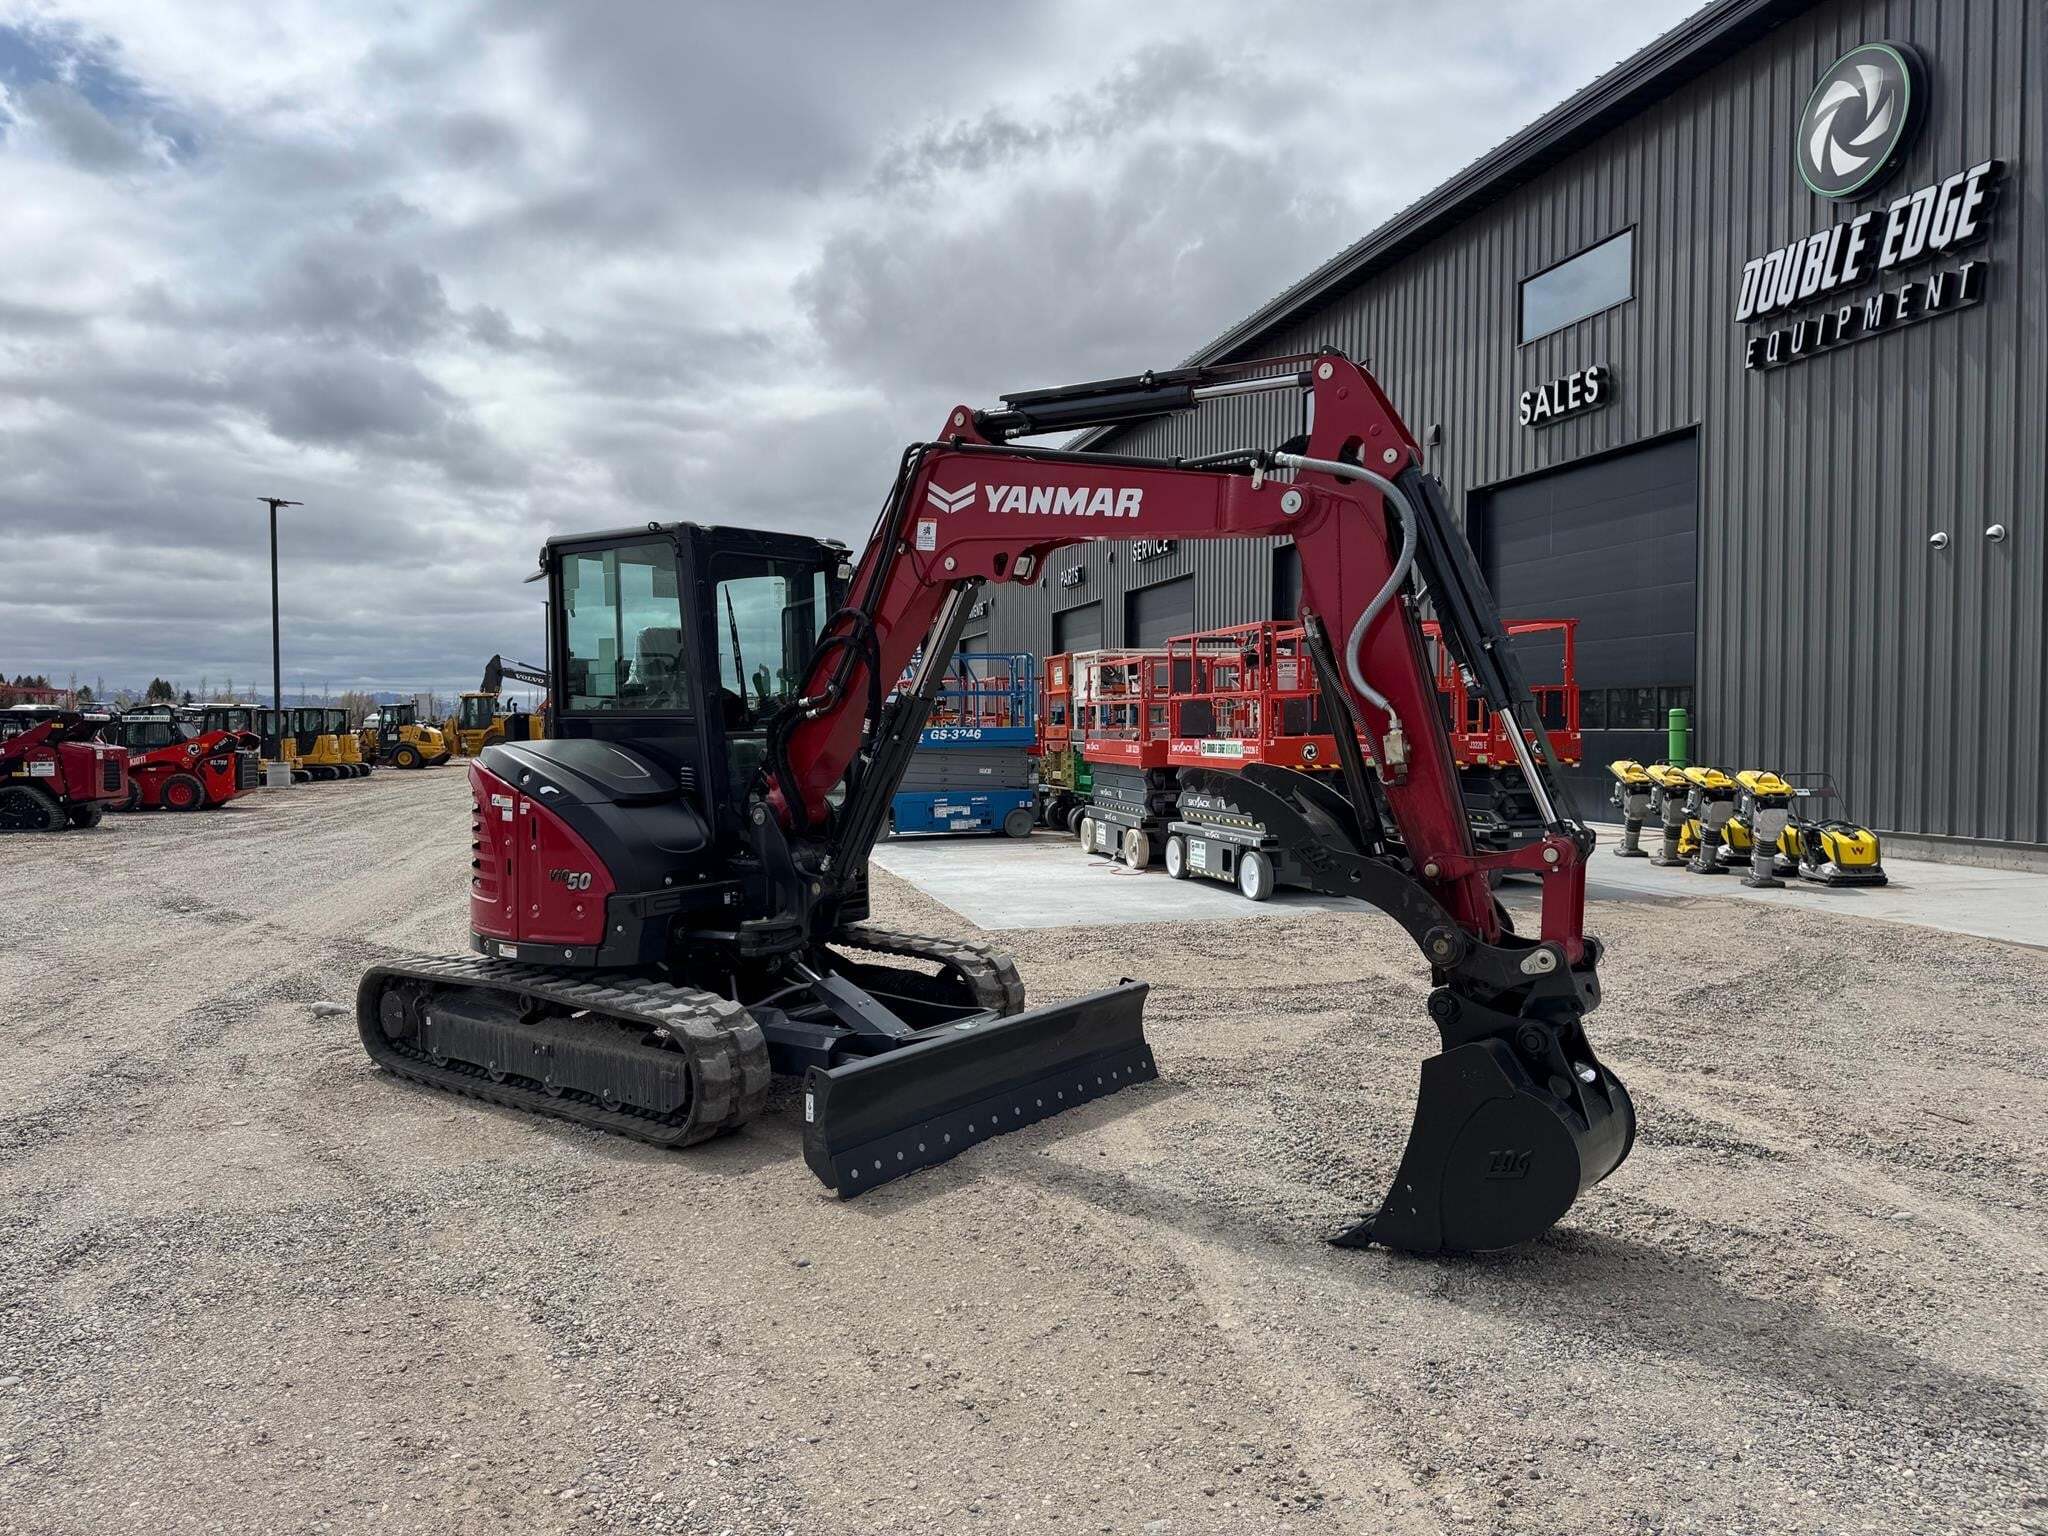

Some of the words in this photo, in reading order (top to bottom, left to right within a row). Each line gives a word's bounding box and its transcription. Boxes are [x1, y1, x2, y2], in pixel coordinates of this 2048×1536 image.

[1734, 211, 1873, 322] DOUBLE
[1878, 160, 1992, 270] EDGE
[1744, 261, 1976, 369] EQUIPMENT
[1519, 365, 1599, 426] SALES
[984, 484, 1144, 518] YANMAR
[1132, 539, 1168, 562] SERVICE
[1060, 565, 1079, 588] PARTS
[515, 673, 545, 684] VOLVO
